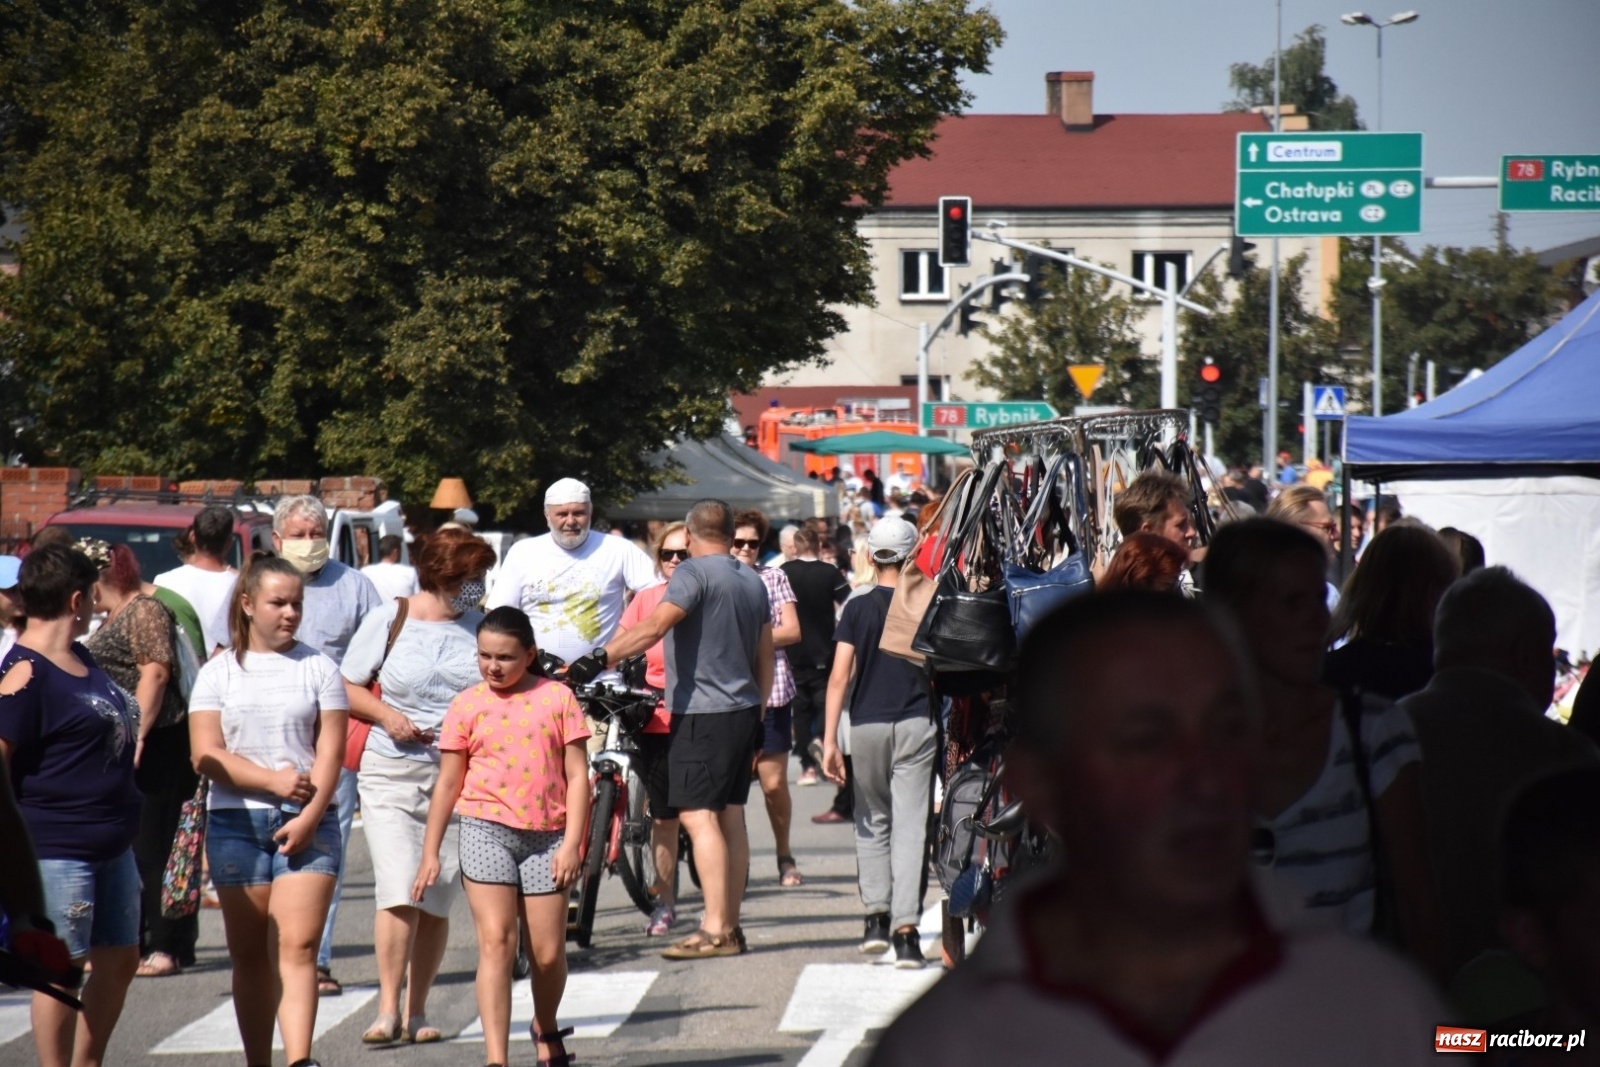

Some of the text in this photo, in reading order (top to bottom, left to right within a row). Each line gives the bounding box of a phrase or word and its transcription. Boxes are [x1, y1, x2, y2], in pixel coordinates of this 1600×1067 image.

[1272, 145, 1336, 158] Centrum
[1517, 160, 1600, 182] 78 Rybn
[1265, 181, 1410, 203] Chałupki PL CZ
[1265, 206, 1381, 223] Ostrava CZ
[940, 407, 1040, 427] 78 Rybnik
